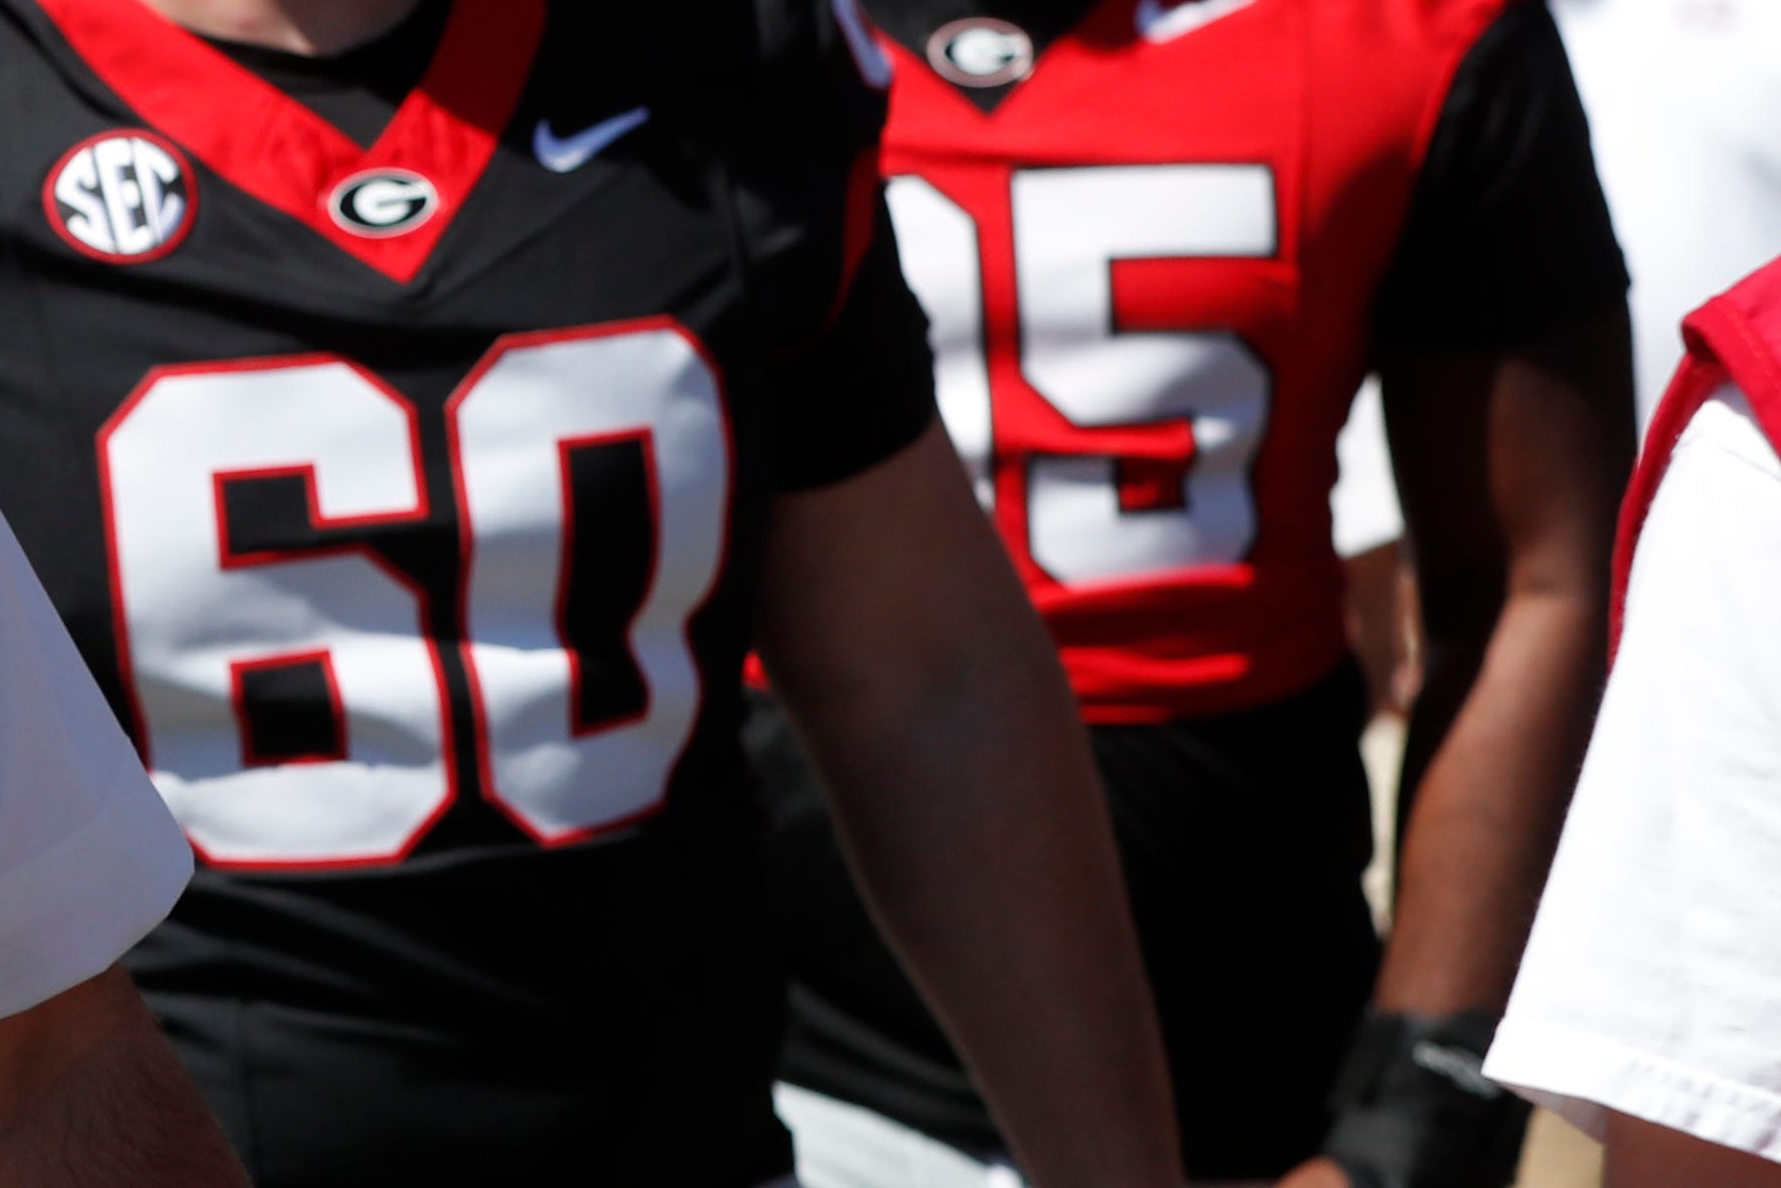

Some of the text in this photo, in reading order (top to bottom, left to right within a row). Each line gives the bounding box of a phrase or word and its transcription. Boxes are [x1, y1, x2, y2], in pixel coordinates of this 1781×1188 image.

[53, 135, 188, 256] SEC
[331, 170, 436, 235] G
[97, 313, 734, 871] 60
